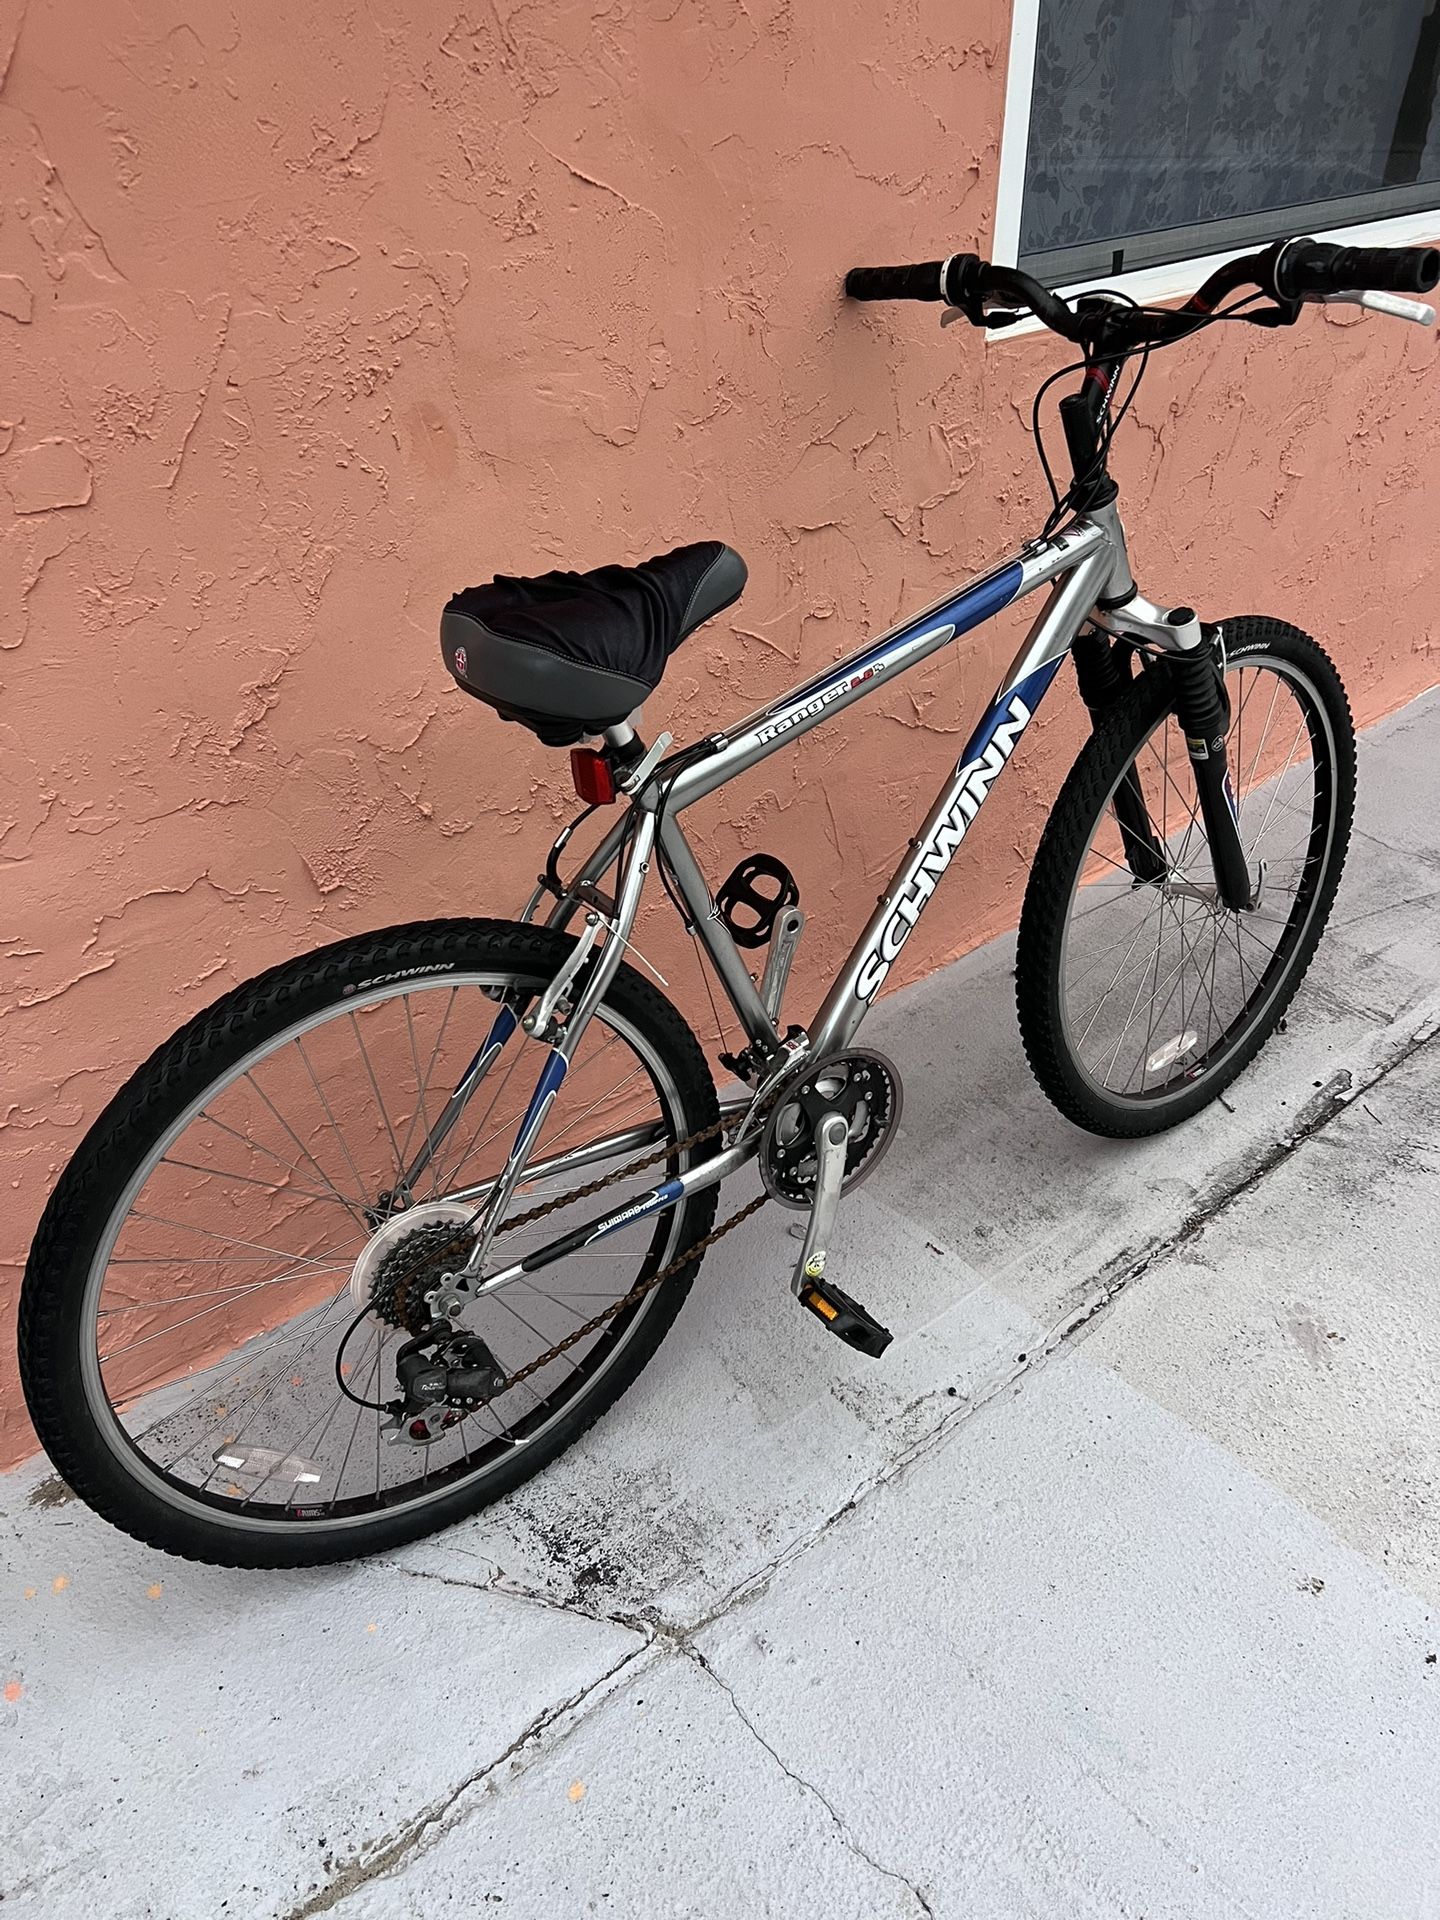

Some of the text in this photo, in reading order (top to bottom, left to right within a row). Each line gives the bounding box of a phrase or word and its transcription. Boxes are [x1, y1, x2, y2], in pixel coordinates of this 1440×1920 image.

[1096, 364, 1121, 424] SCHWINN
[755, 681, 848, 746] Ranger
[854, 695, 1033, 1004] SCHWINN
[357, 962, 456, 990] SCHWINN
